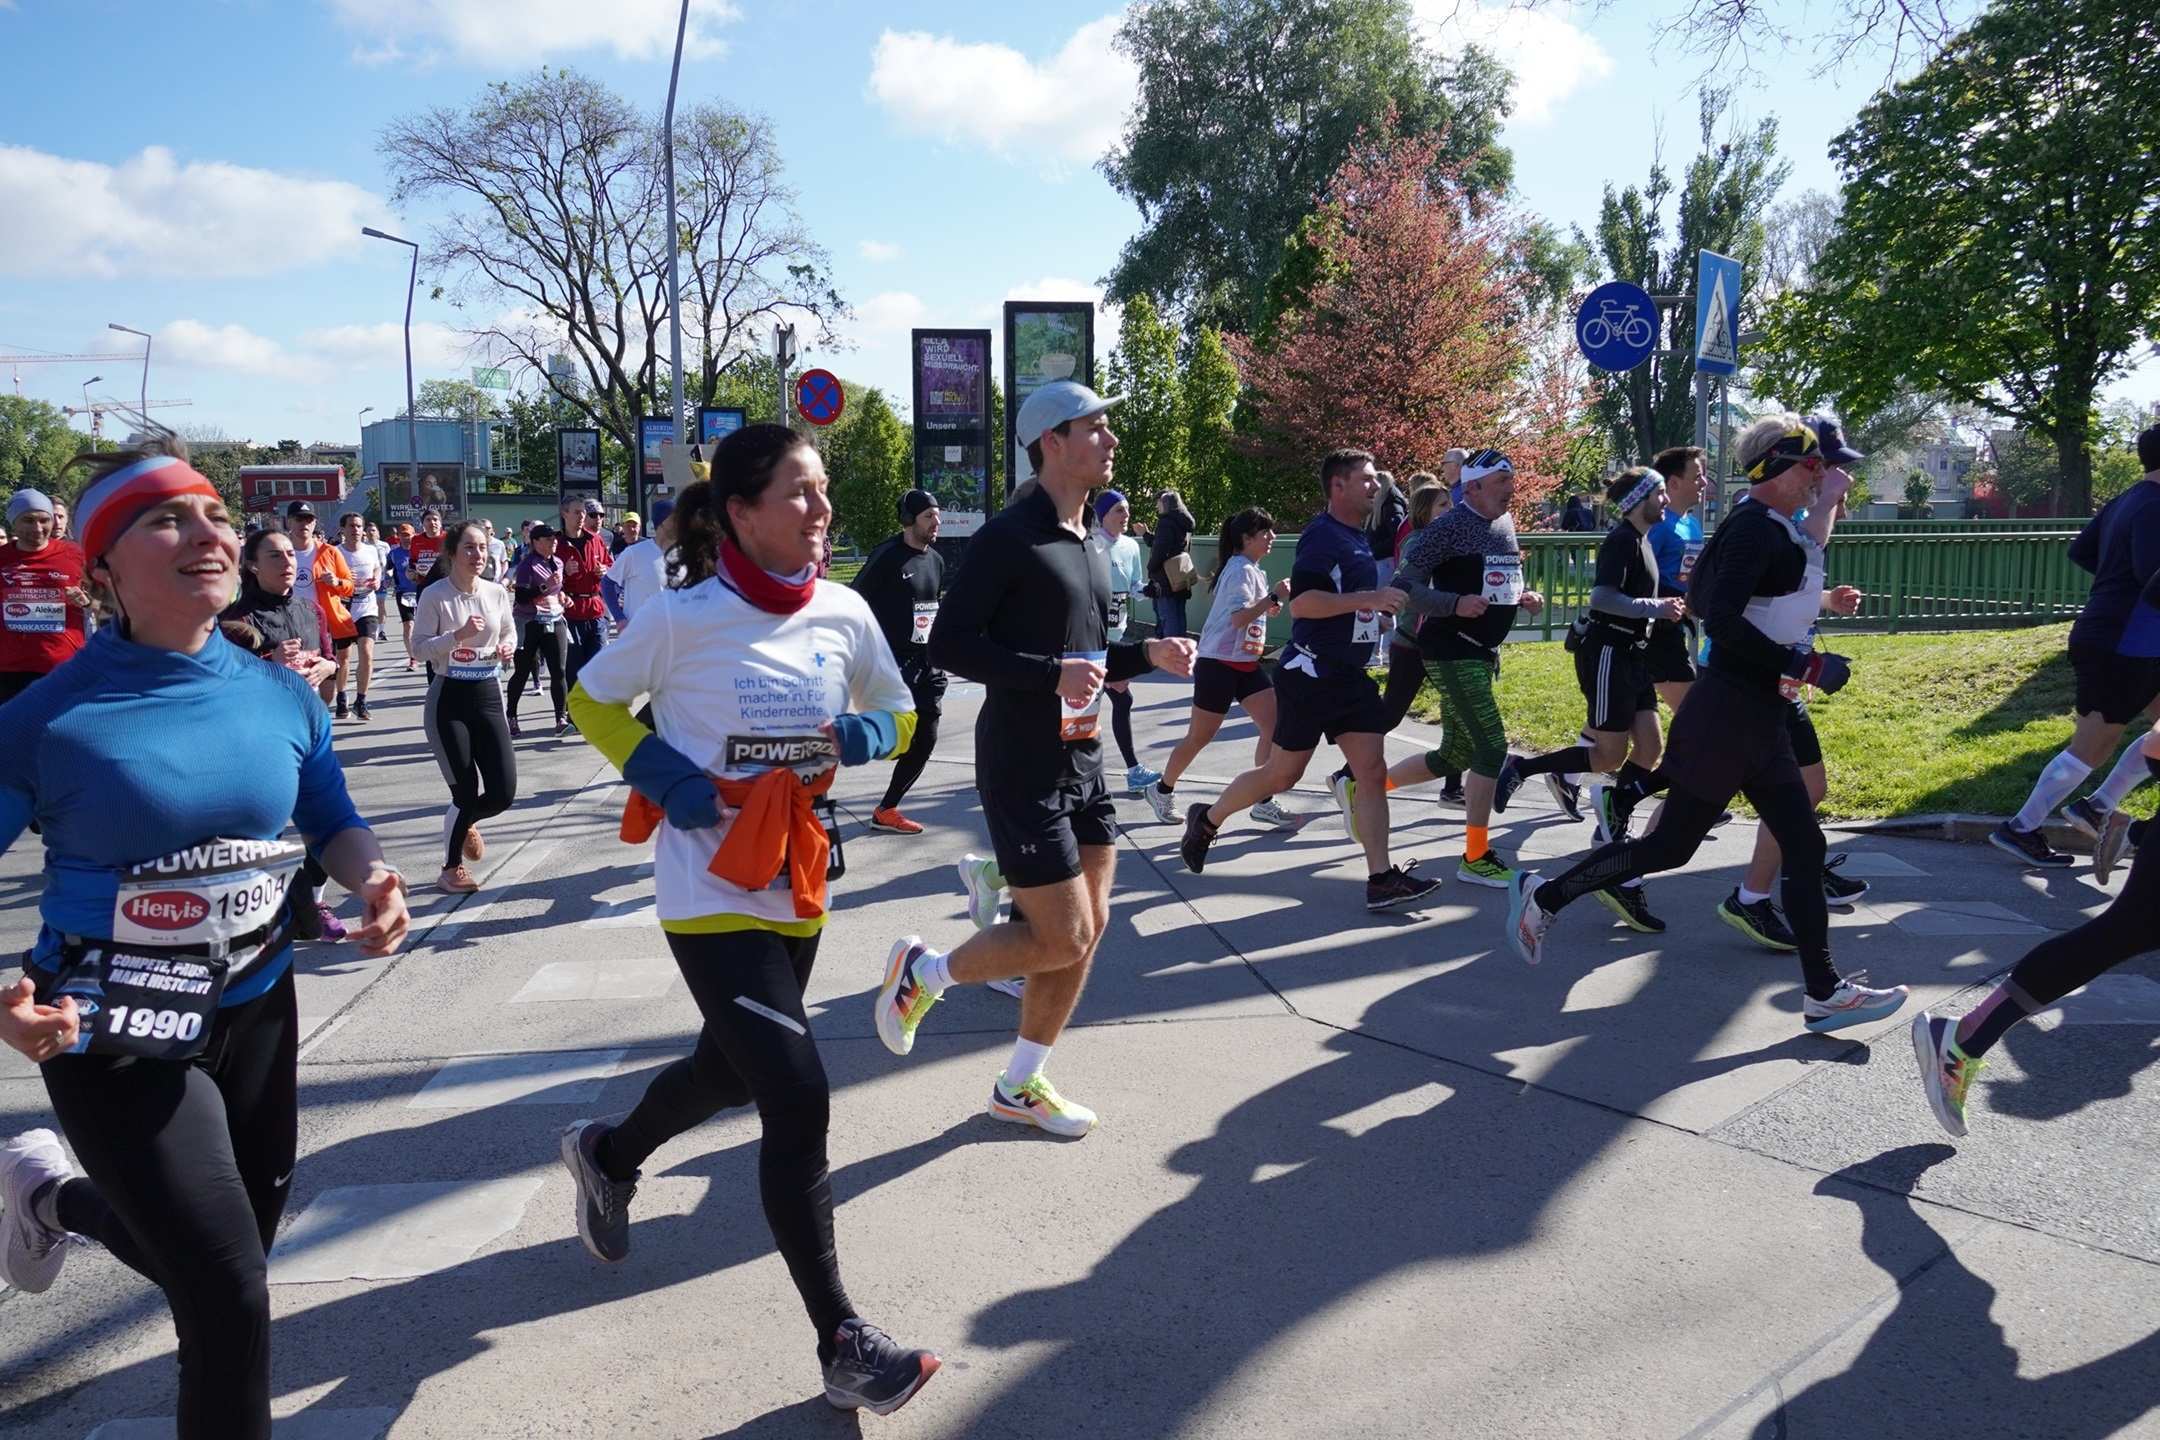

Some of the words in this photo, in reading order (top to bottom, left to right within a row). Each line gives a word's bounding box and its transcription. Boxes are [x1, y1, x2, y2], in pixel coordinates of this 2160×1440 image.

[925, 344, 950, 353] WIRD
[924, 353, 963, 362] SEXUELL
[926, 421, 957, 430] Unsere
[734, 677, 755, 689] Ich
[807, 688, 826, 702] Für
[217, 872, 287, 920] 1990A
[132, 899, 204, 922] Hervis
[111, 954, 171, 975] COMPETE,
[108, 969, 147, 987] MAKE
[147, 975, 212, 995] HISTORY!
[109, 1005, 203, 1041] 1990
